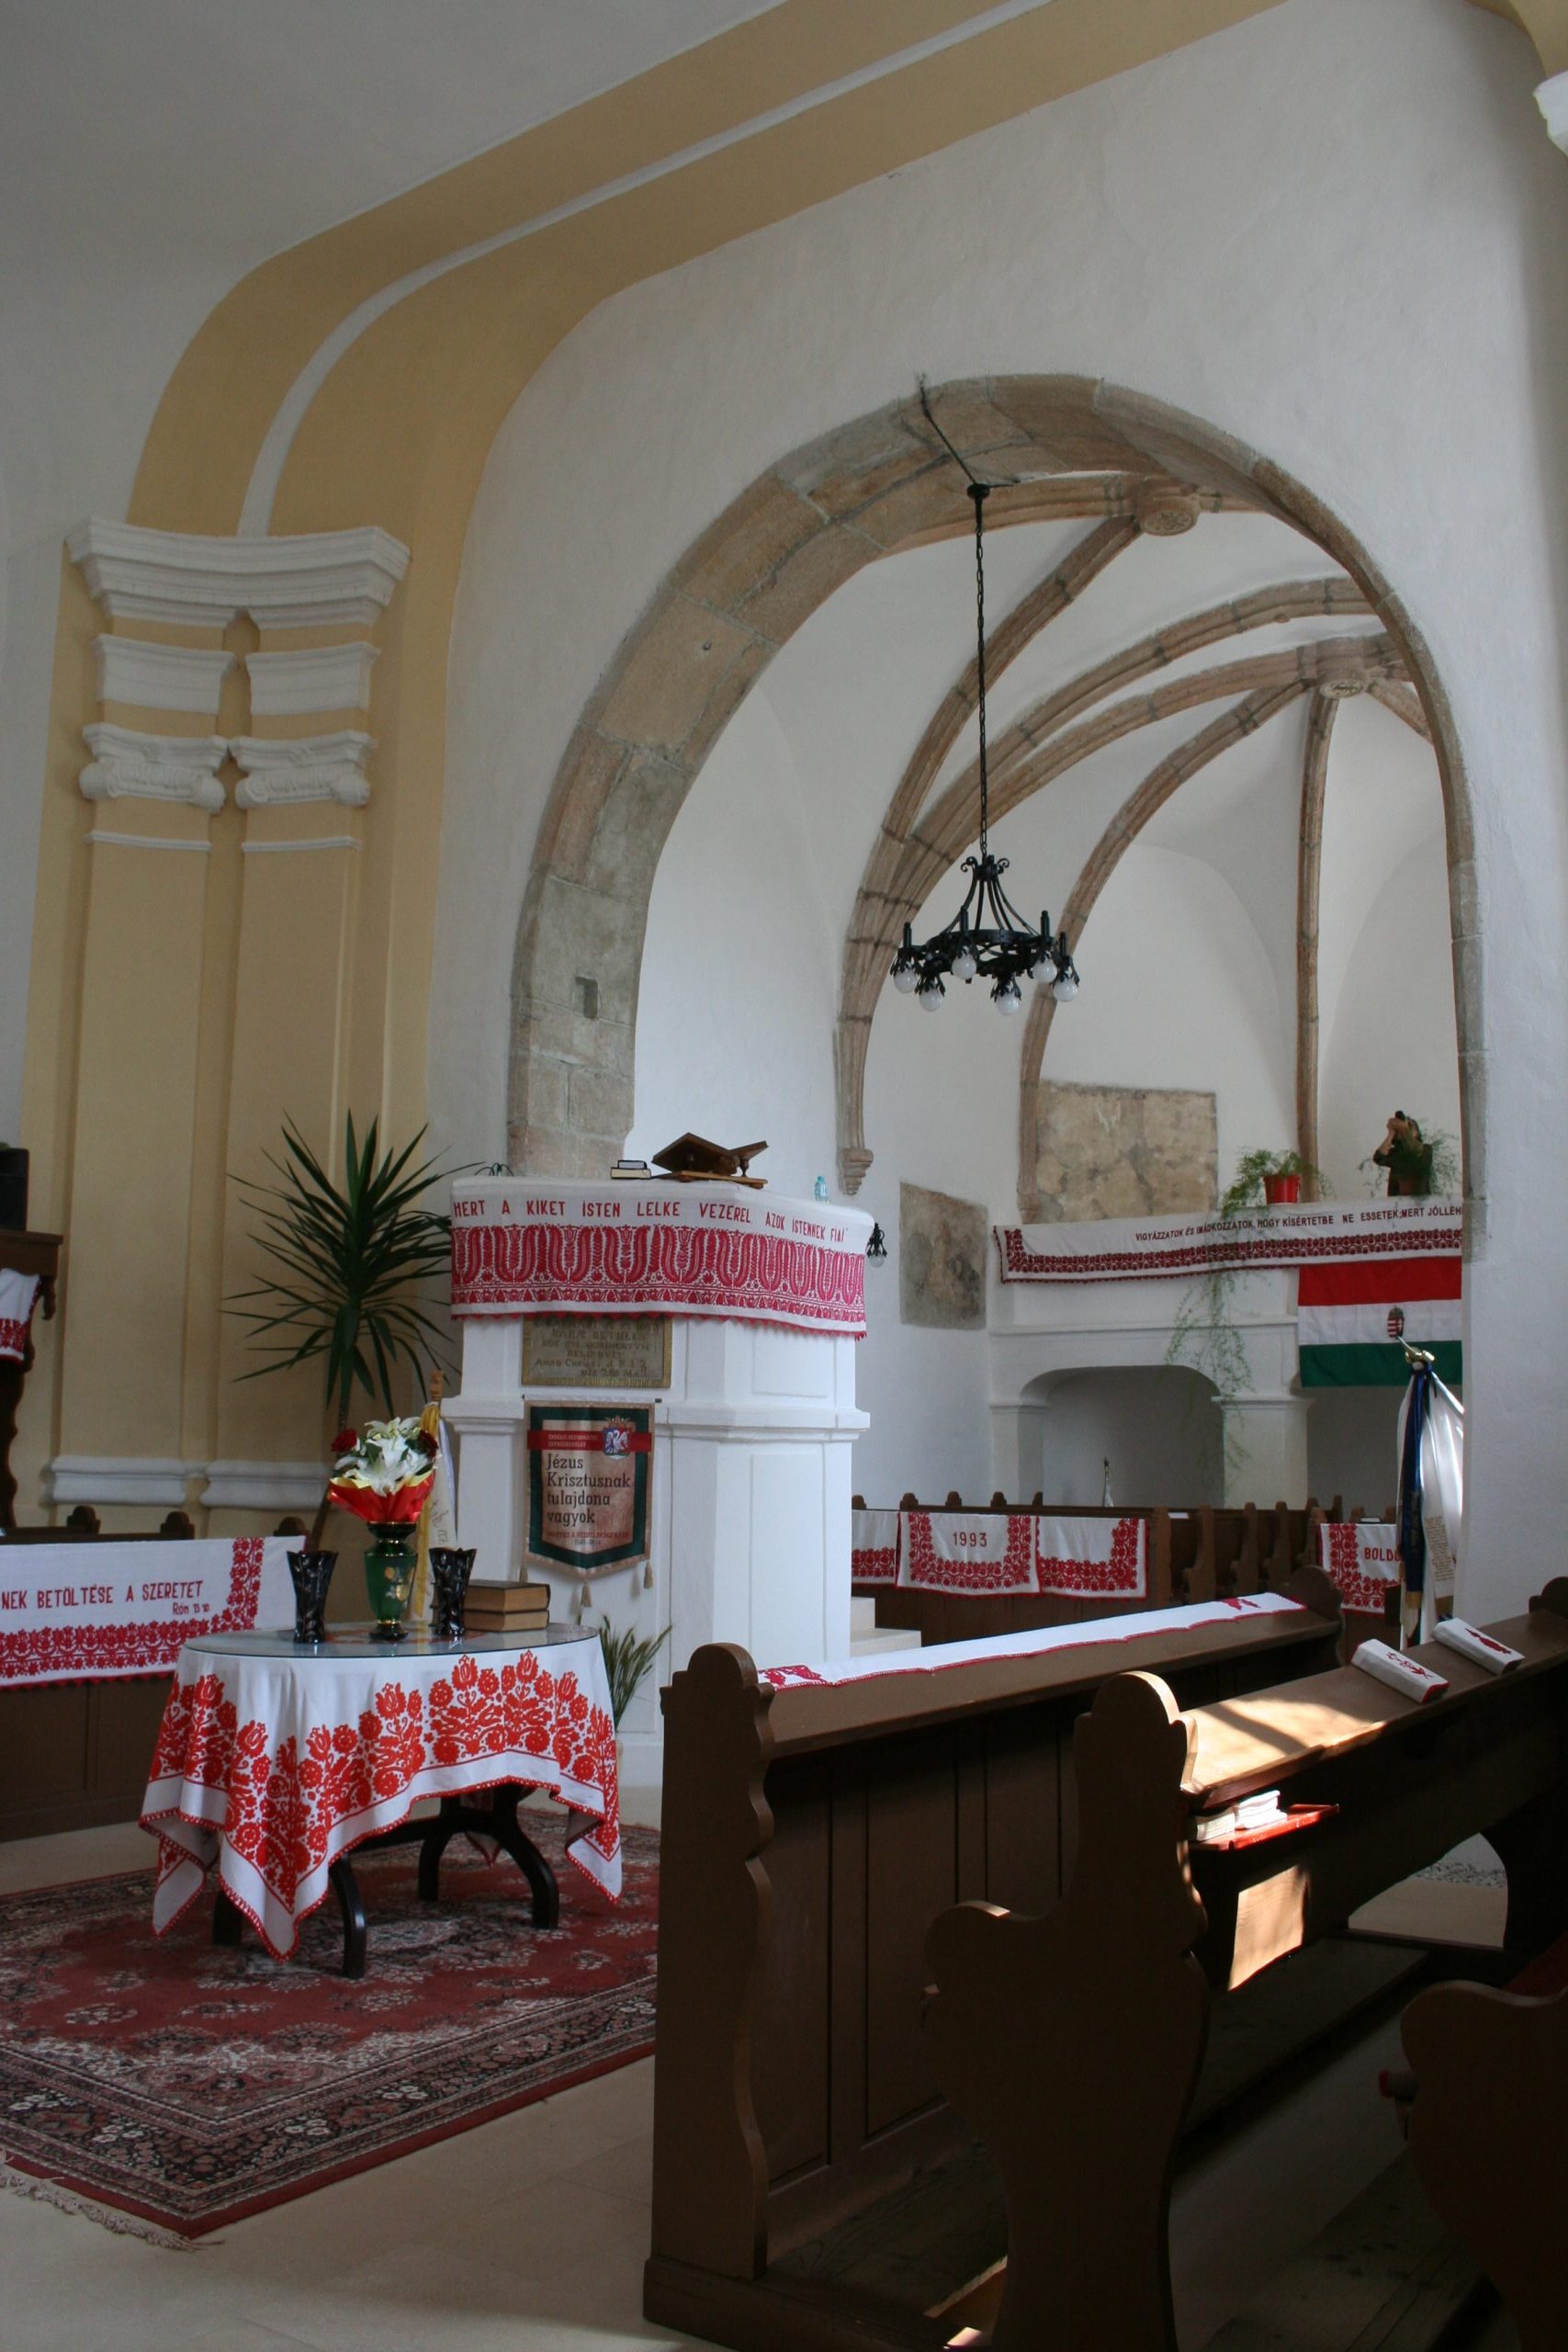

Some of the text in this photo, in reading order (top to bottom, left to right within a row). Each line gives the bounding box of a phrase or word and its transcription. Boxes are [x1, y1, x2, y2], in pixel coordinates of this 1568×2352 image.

[502, 1200, 511, 1215] A
[637, 1202, 681, 1216] LELKE
[765, 1212, 785, 1231] AZOK
[1257, 1218, 1280, 1227] HOGY
[1343, 1214, 1354, 1223] NE
[547, 1453, 583, 1470] Jézus
[547, 1471, 631, 1487] Krisztusnak
[547, 1490, 610, 1508] tulajdona
[547, 1509, 595, 1526] vagyok
[952, 1532, 987, 1547] 1993
[2, 1580, 204, 1610] NEK BETÖLTÉSE A SZERETET
